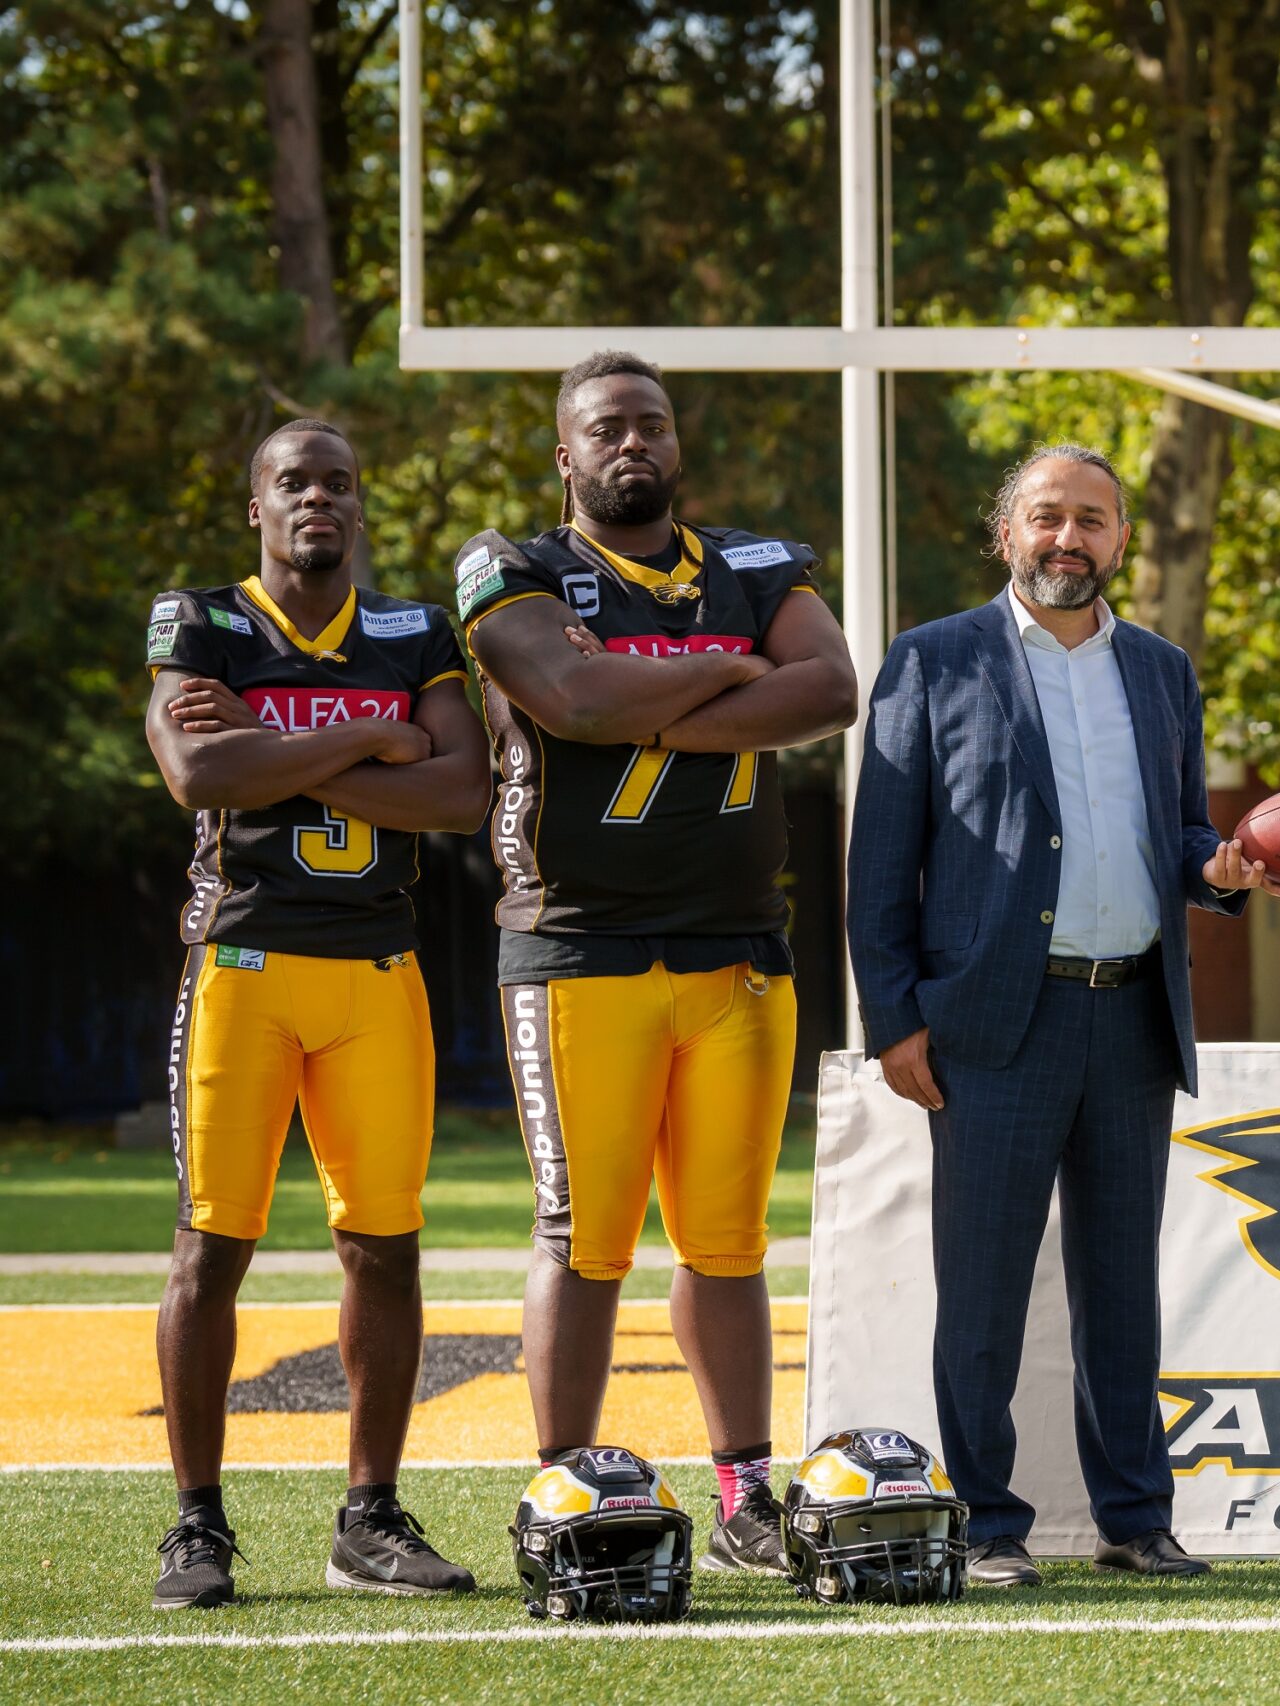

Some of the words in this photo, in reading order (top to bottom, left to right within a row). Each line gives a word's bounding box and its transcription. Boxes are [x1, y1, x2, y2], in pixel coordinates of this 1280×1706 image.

[725, 547, 766, 560] Allianz
[567, 581, 597, 609] C
[364, 614, 404, 625] Allianz
[607, 1497, 651, 1508] Riddell
